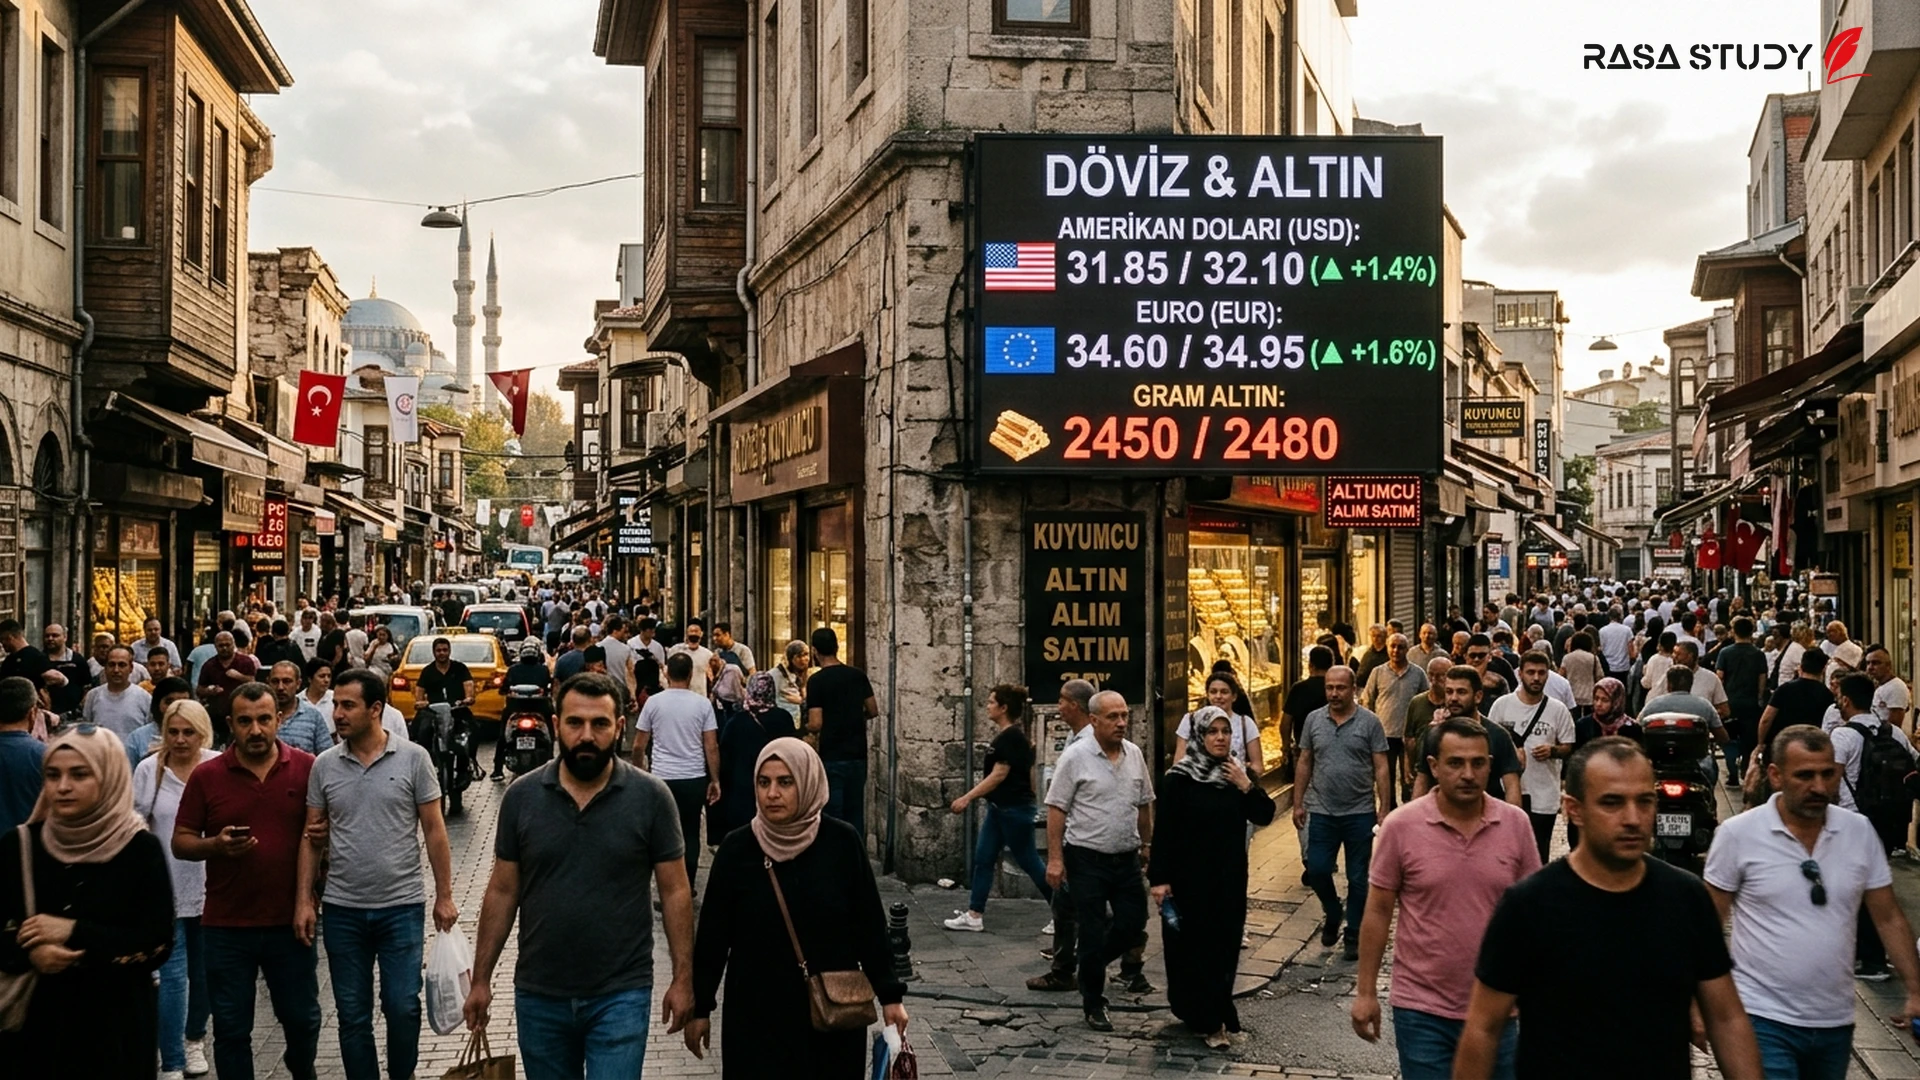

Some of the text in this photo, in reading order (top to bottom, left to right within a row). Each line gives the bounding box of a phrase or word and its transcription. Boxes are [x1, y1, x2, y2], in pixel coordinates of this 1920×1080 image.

[1047, 145, 1382, 198] DÖVİZ & ALTIN
[1058, 212, 1360, 246] AMERİKAN DOLARI (USD):
[1067, 250, 1168, 284] 31.85
[1179, 251, 1192, 284] /
[1203, 251, 1304, 285] 32.10
[1137, 301, 1282, 329] EURO (EUR):
[1067, 334, 1167, 368] 34.60
[1179, 335, 1192, 368] /
[1203, 335, 1304, 369] 34.95
[1134, 384, 1285, 407] GRAM ALTIN:
[1064, 416, 1337, 460] 2450 / 2480
[1332, 484, 1415, 499] ALTUMCU
[1333, 505, 1415, 518] ALIM SATIM
[1034, 523, 1139, 549] KUYUMCU
[1045, 567, 1127, 591] ALTIN
[1051, 603, 1120, 626] ALIM
[1043, 637, 1129, 661] SATIM
